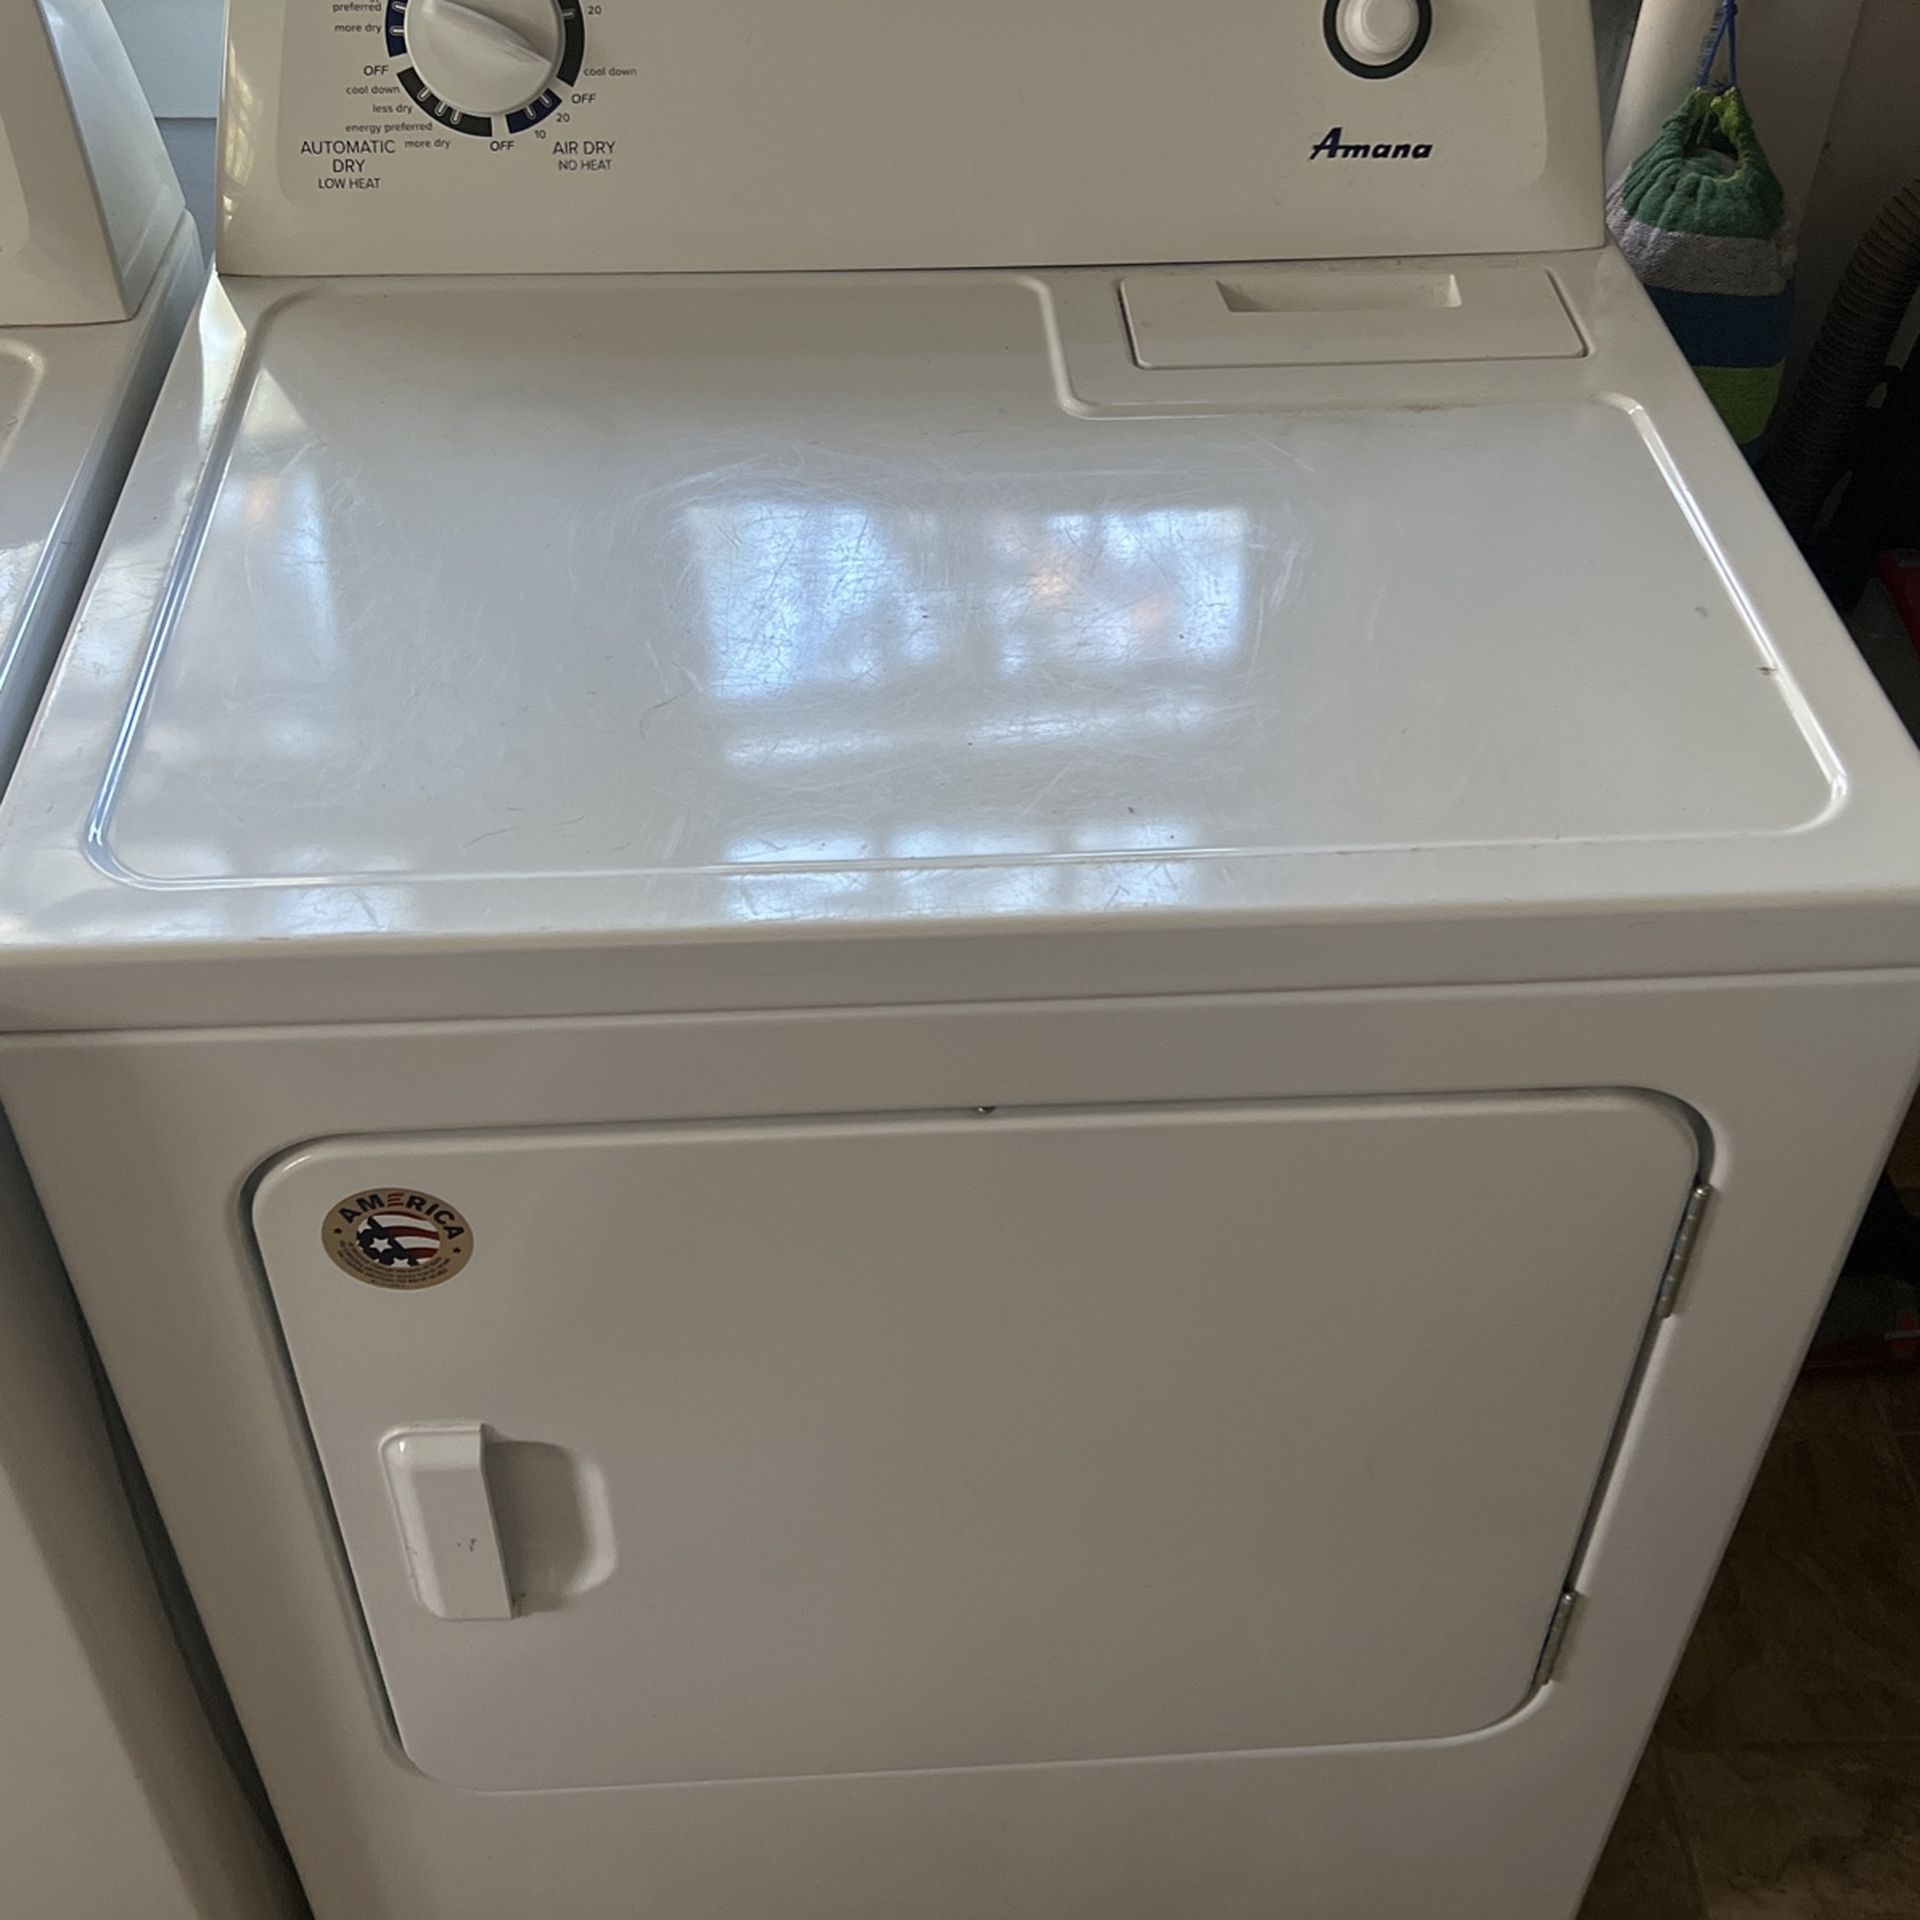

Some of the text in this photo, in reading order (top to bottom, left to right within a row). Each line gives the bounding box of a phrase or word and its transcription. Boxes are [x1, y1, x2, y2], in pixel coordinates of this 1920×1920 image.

[332, 2, 382, 13] preferred
[588, 5, 602, 16] 20
[334, 23, 382, 34] more dry
[363, 65, 389, 76] OFF
[583, 67, 638, 76] cool down
[345, 85, 400, 95] cool down
[571, 93, 597, 104] OFF
[372, 104, 413, 115] less dry
[556, 113, 571, 123] 20
[345, 122, 433, 134] energy preferred
[534, 130, 547, 140] 10
[300, 140, 396, 155] AUTOMATIC
[404, 138, 451, 150] more dry
[489, 140, 516, 152] OFF
[553, 141, 616, 155] AIR DRY
[1309, 126, 1433, 160] Amana
[332, 159, 365, 173] DRY
[558, 159, 612, 171] NO HEAT
[318, 177, 381, 189] LOW HEAT
[338, 1192, 465, 1240] AMERICA
